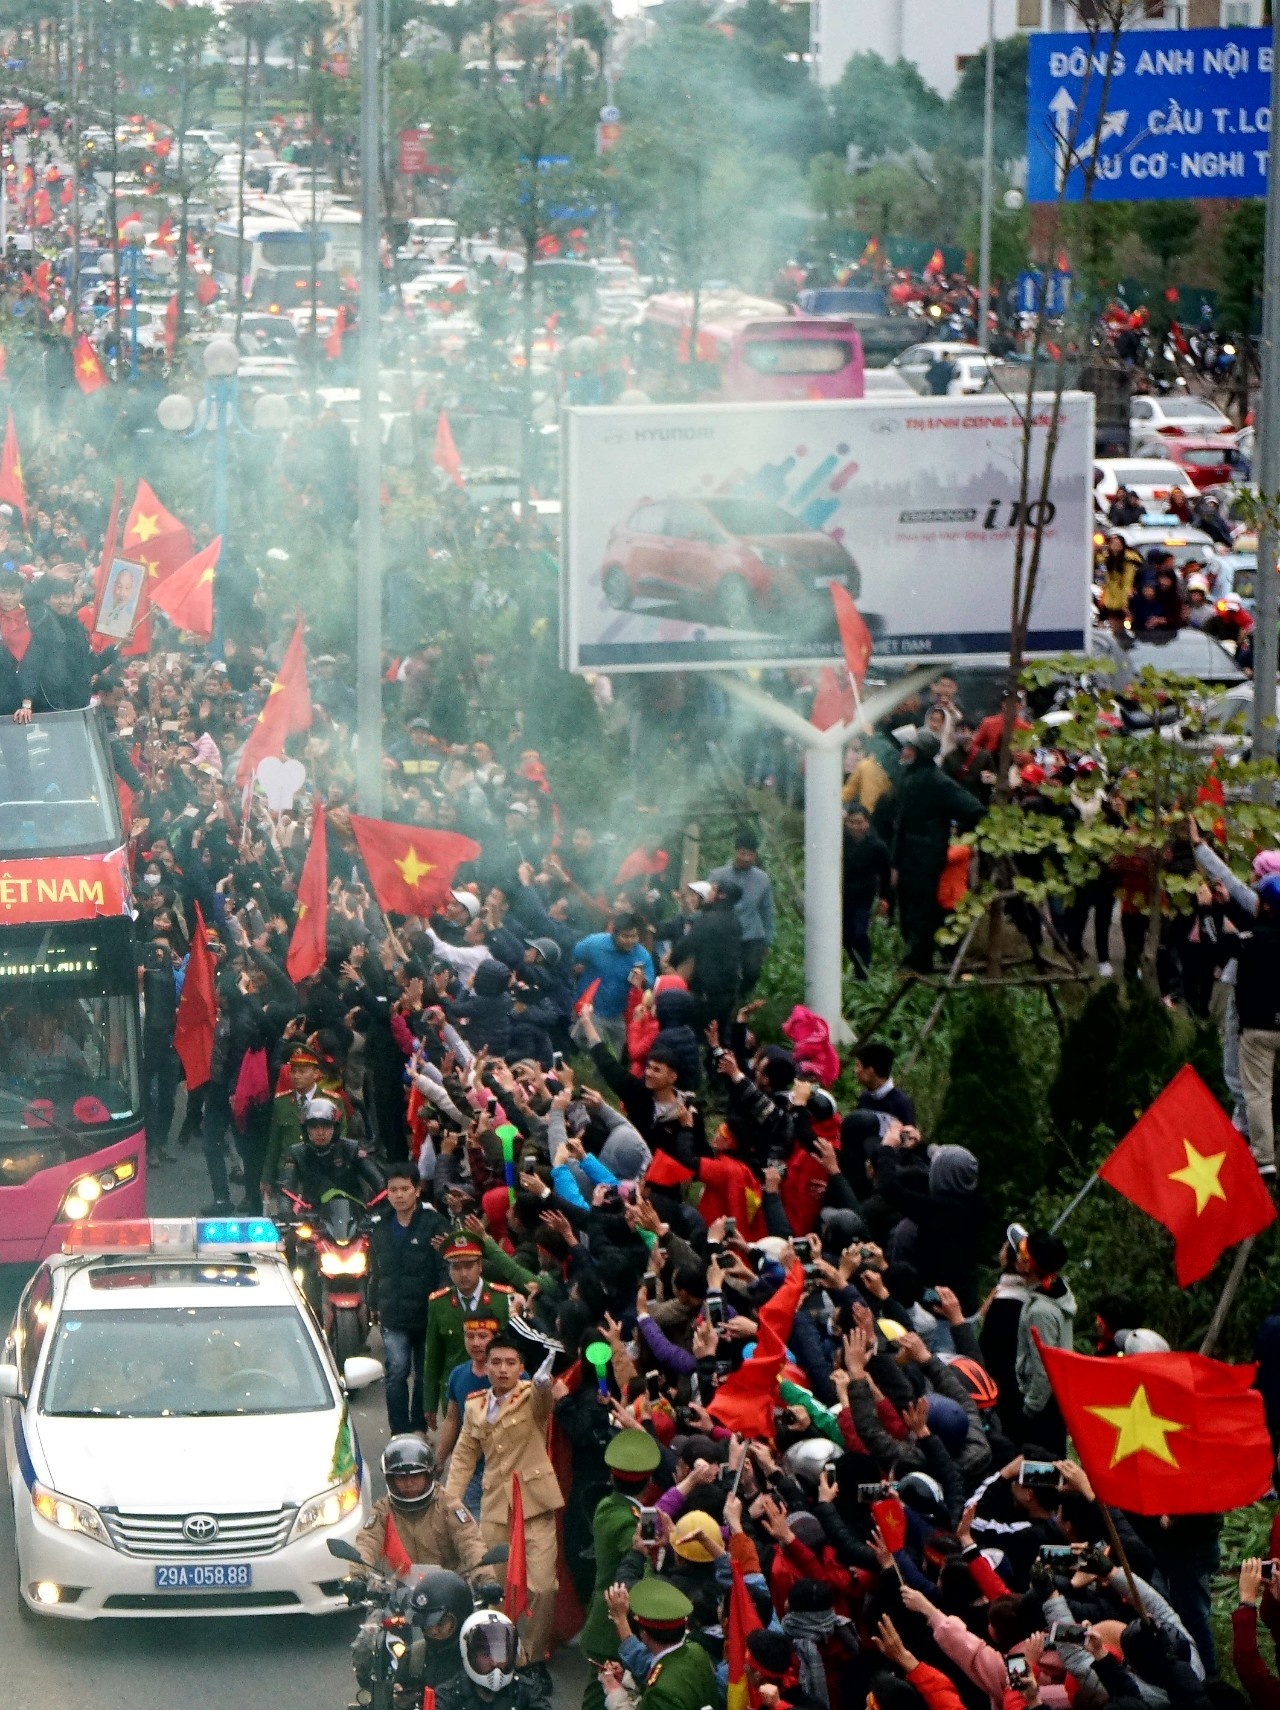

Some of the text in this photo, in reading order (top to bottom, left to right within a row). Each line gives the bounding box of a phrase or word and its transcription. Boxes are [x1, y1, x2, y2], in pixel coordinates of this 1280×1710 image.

[1048, 46, 1126, 78] ĐÔNG
[1134, 47, 1194, 76] ANH
[1202, 42, 1249, 79] NỘI
[1147, 97, 1203, 135] CẦU
[37, 880, 105, 905] NAM
[158, 1566, 248, 1586] 29A-058.88
